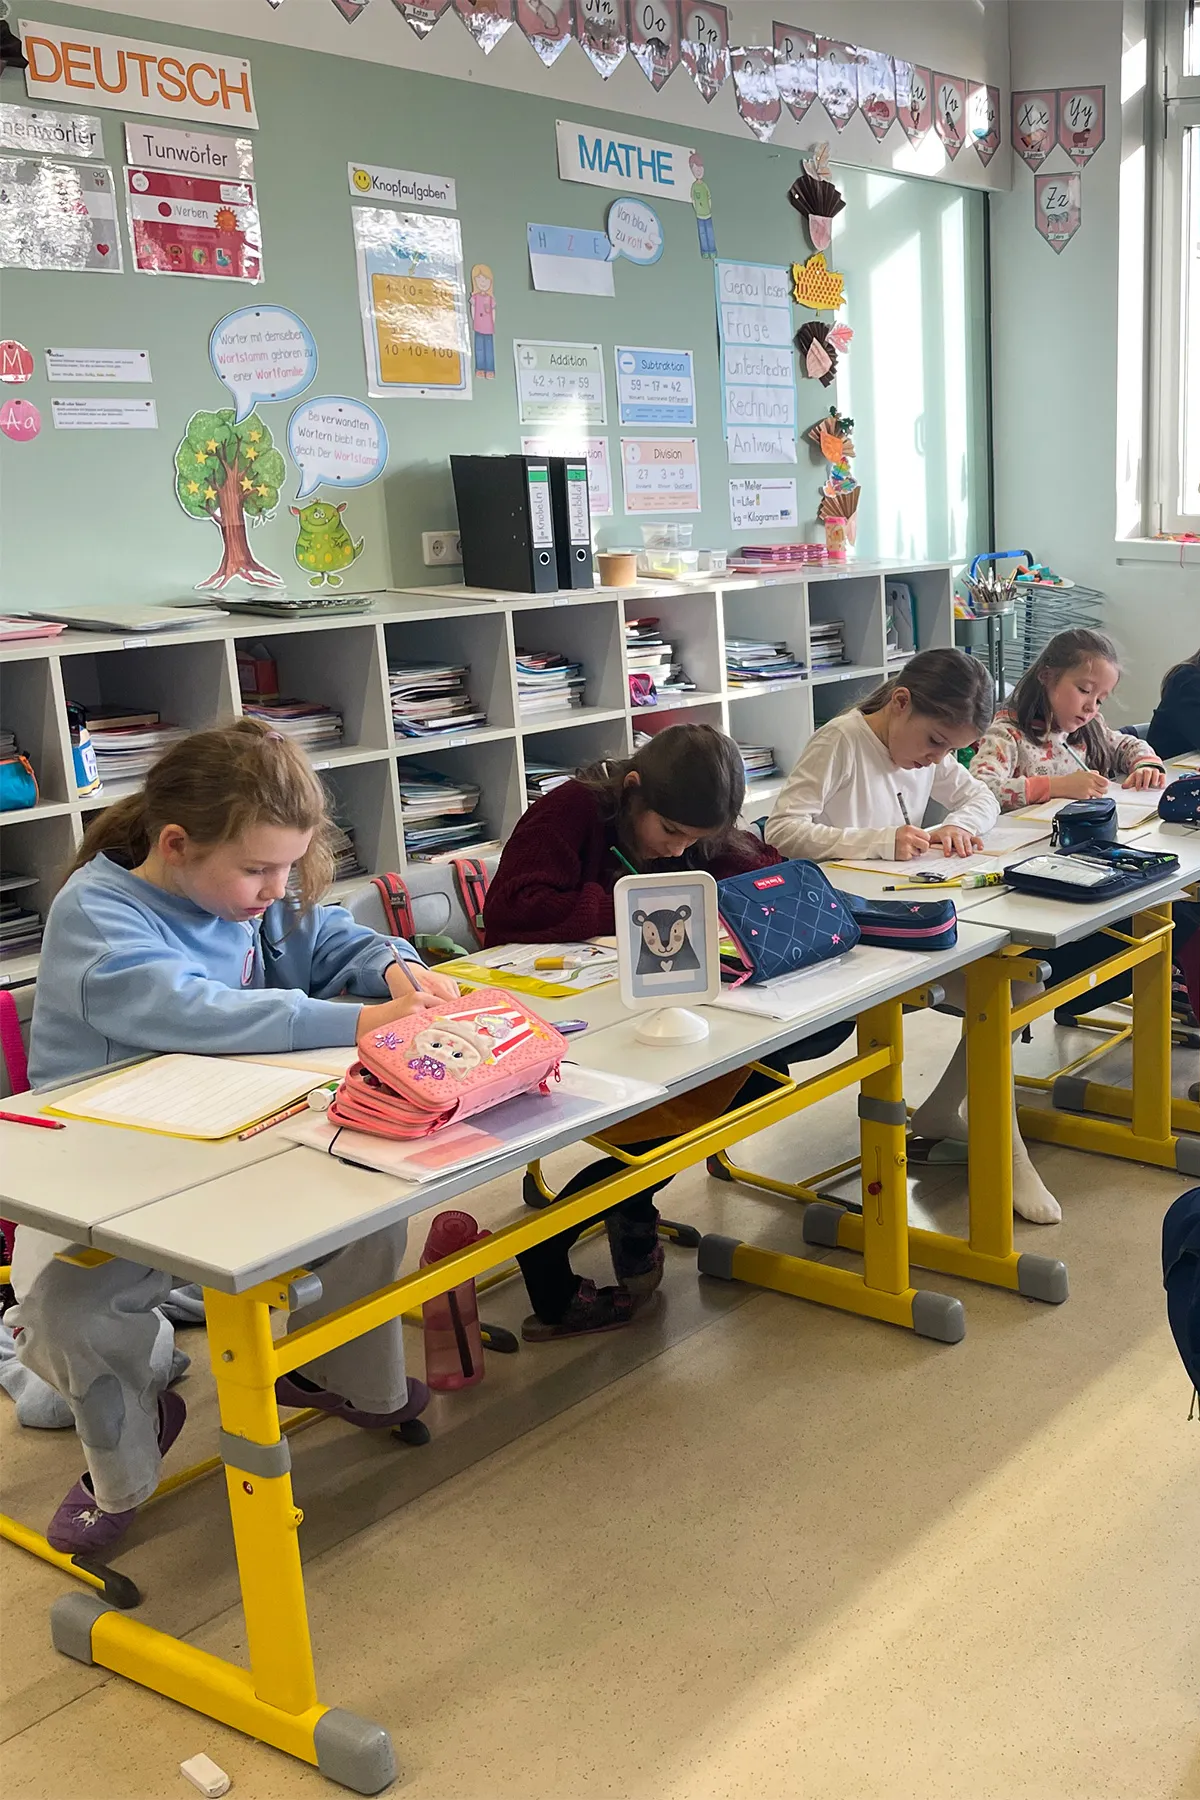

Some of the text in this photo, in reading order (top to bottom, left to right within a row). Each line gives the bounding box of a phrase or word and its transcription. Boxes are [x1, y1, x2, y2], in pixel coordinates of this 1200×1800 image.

[643, 5, 666, 32] Oo
[695, 15, 718, 44] Pp
[25, 36, 252, 113] DEUTSCH
[1019, 103, 1049, 127] Xx
[1069, 97, 1093, 127] Yy
[143, 134, 228, 167] Tunwörter
[577, 134, 675, 186] MATHE
[1046, 187, 1070, 209] Zz
[175, 205, 209, 220] Verben
[615, 229, 626, 241] zu
[726, 311, 770, 343] Frage
[3, 348, 24, 376] M
[385, 344, 399, 356] 10
[549, 353, 588, 367] Addition
[532, 375, 545, 387] 42
[578, 376, 590, 389] 59
[631, 379, 642, 391] 59
[671, 381, 682, 393] 42
[729, 390, 789, 423] Rechnung
[653, 448, 683, 461] Division
[733, 431, 784, 455] Antwort
[637, 469, 649, 480] 27
[733, 512, 742, 526] kg
[747, 511, 780, 525] Kilogramm
